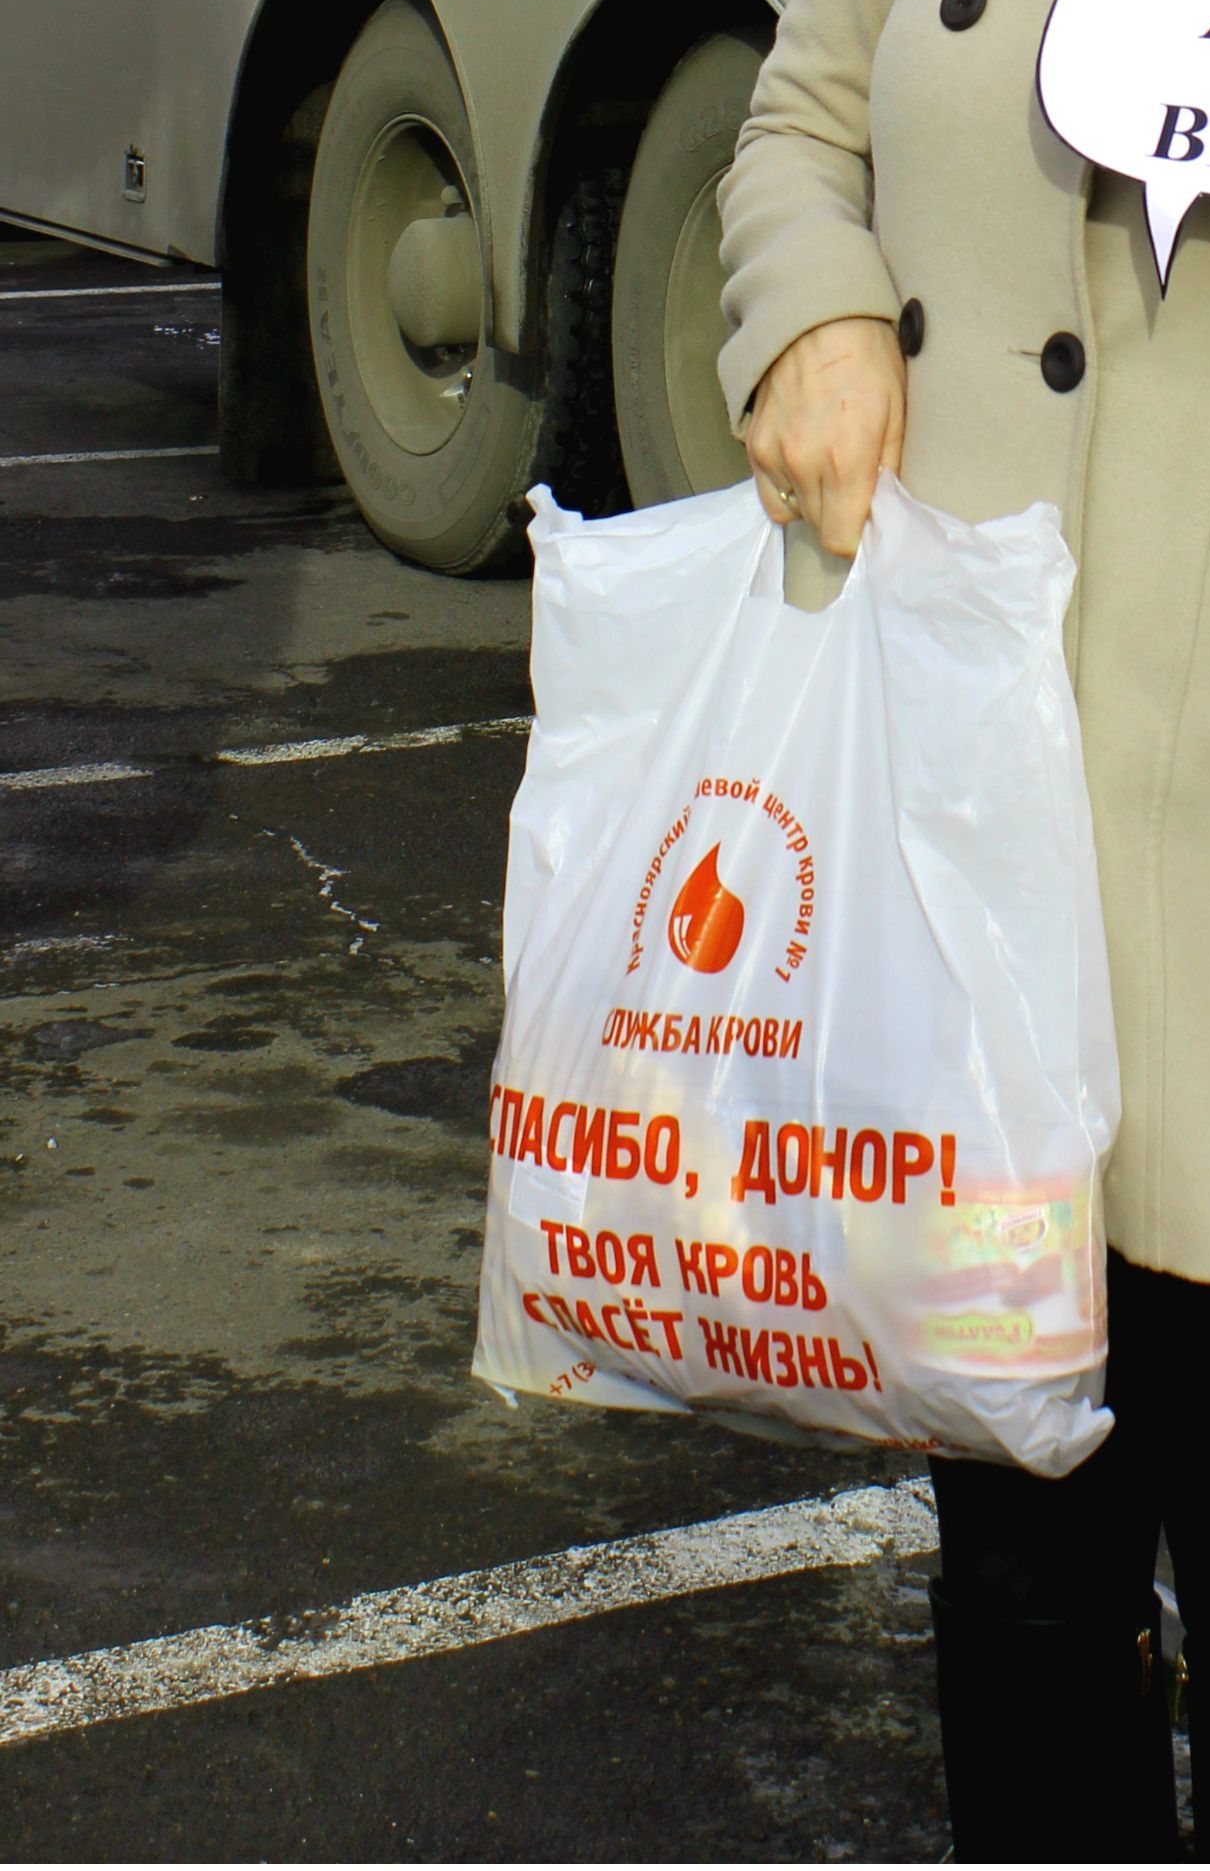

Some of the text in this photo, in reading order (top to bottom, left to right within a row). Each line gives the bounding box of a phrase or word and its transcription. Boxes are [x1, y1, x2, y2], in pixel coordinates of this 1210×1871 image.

[762, 793, 809, 856] центр
[795, 855, 815, 936] крови
[705, 1014, 803, 1060] КРОВИ
[730, 1119, 957, 1207] ДОНОР!
[540, 1218, 828, 1312] ТВОЯ КРОВЬ
[522, 1292, 883, 1393] СПАСЁТ ЖИЗНЬ!
